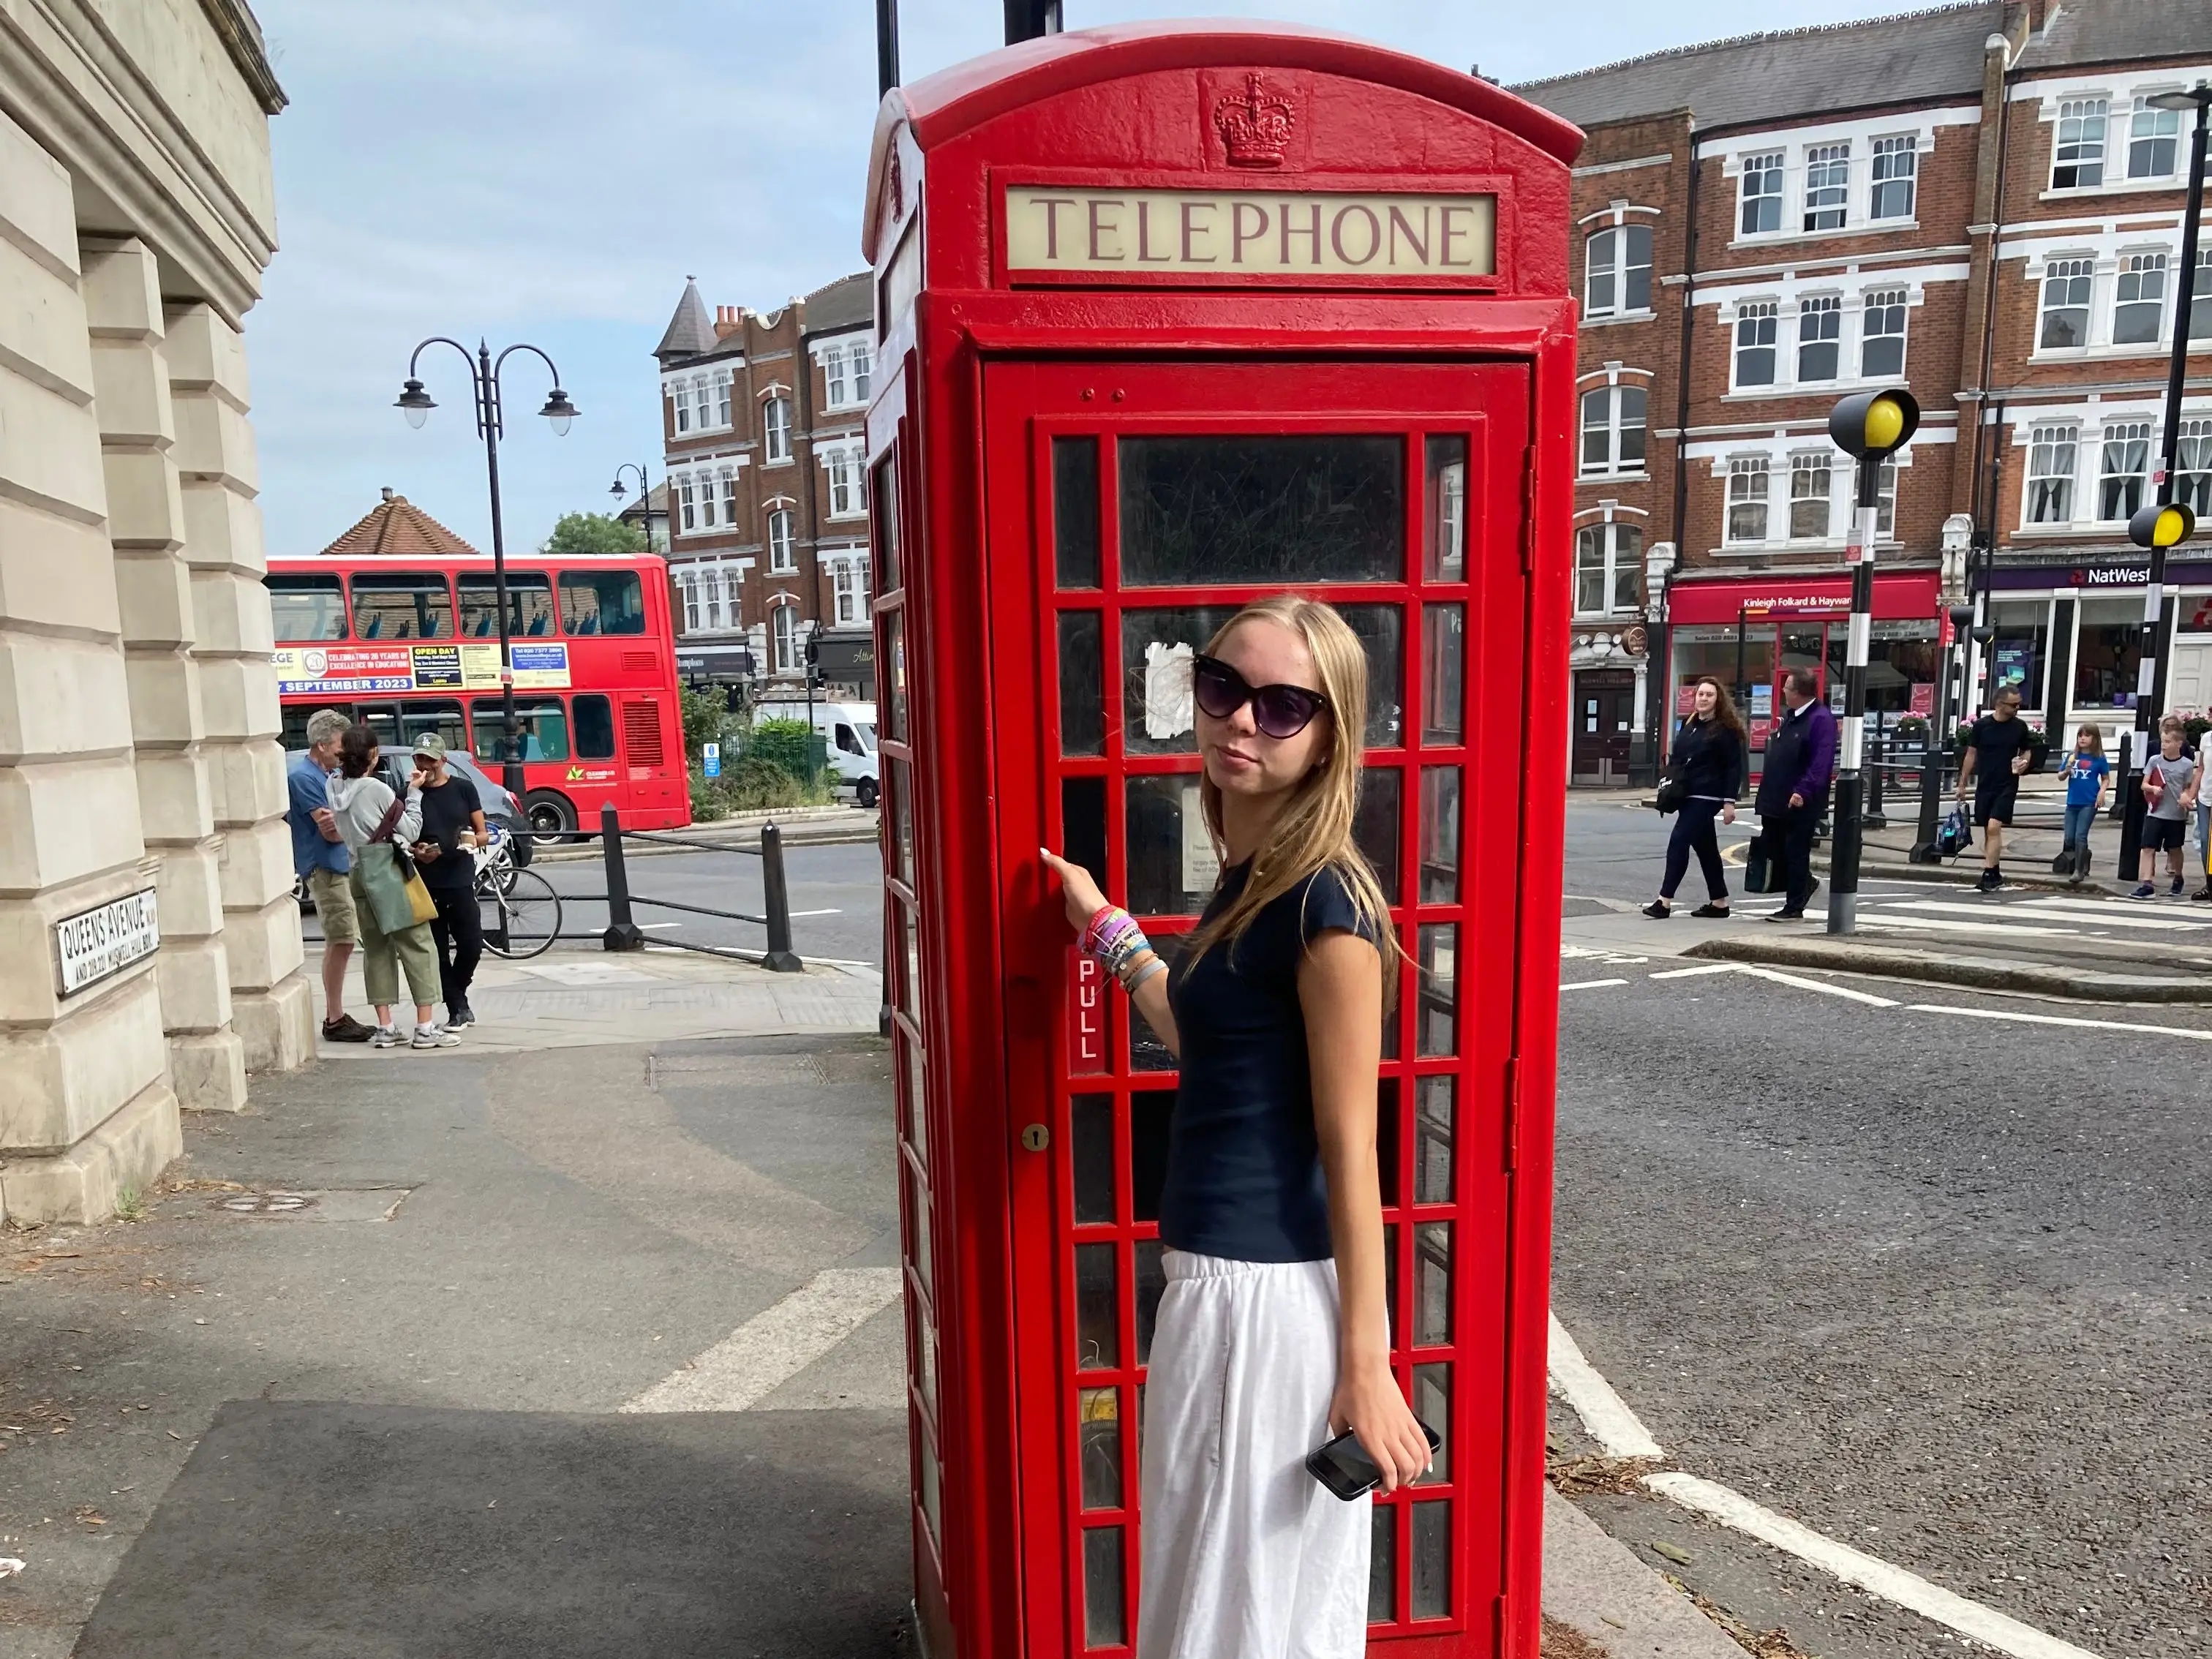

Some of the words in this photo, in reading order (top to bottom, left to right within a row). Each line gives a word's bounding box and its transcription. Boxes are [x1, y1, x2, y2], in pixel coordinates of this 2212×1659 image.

[1029, 198, 1475, 266] TELEPHONE
[1744, 598, 1776, 608] Kinleigh
[1778, 597, 1808, 606] Folkard
[1810, 597, 1817, 606] &
[1818, 597, 1851, 607] Haywar
[328, 652, 369, 661] CELEBRATING
[329, 661, 367, 669] EXCELLENCE
[285, 680, 372, 691] SEPTEMBER
[375, 679, 408, 690] 2023
[64, 912, 105, 960] QUEENS
[108, 898, 145, 941] AVENUE
[76, 963, 87, 984] AND
[108, 942, 131, 968] MUSWELL
[131, 936, 142, 956] HILL
[1080, 960, 1096, 1058] PULL
